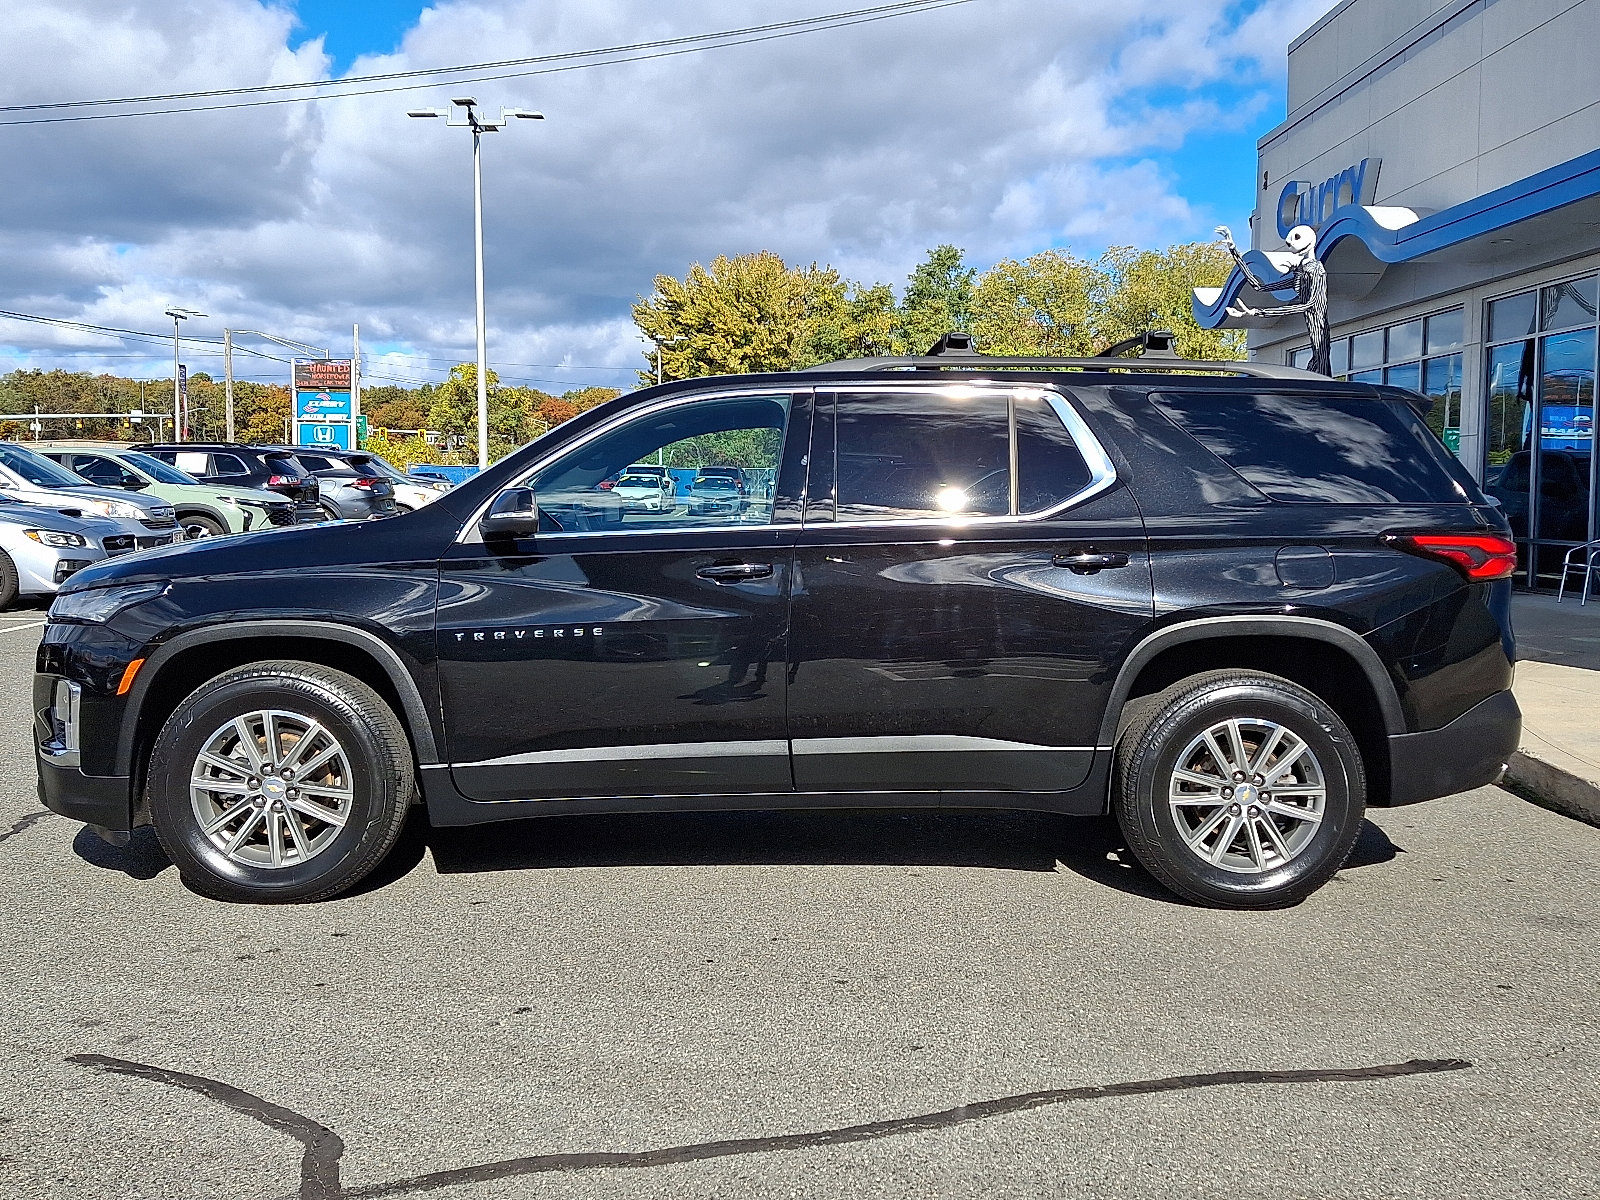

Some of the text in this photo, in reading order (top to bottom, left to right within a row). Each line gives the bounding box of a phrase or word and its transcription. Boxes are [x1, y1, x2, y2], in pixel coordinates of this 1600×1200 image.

[1276, 158, 1382, 239] Curry
[310, 364, 350, 373] HAUNTED
[454, 627, 603, 642] TRAVERSE
